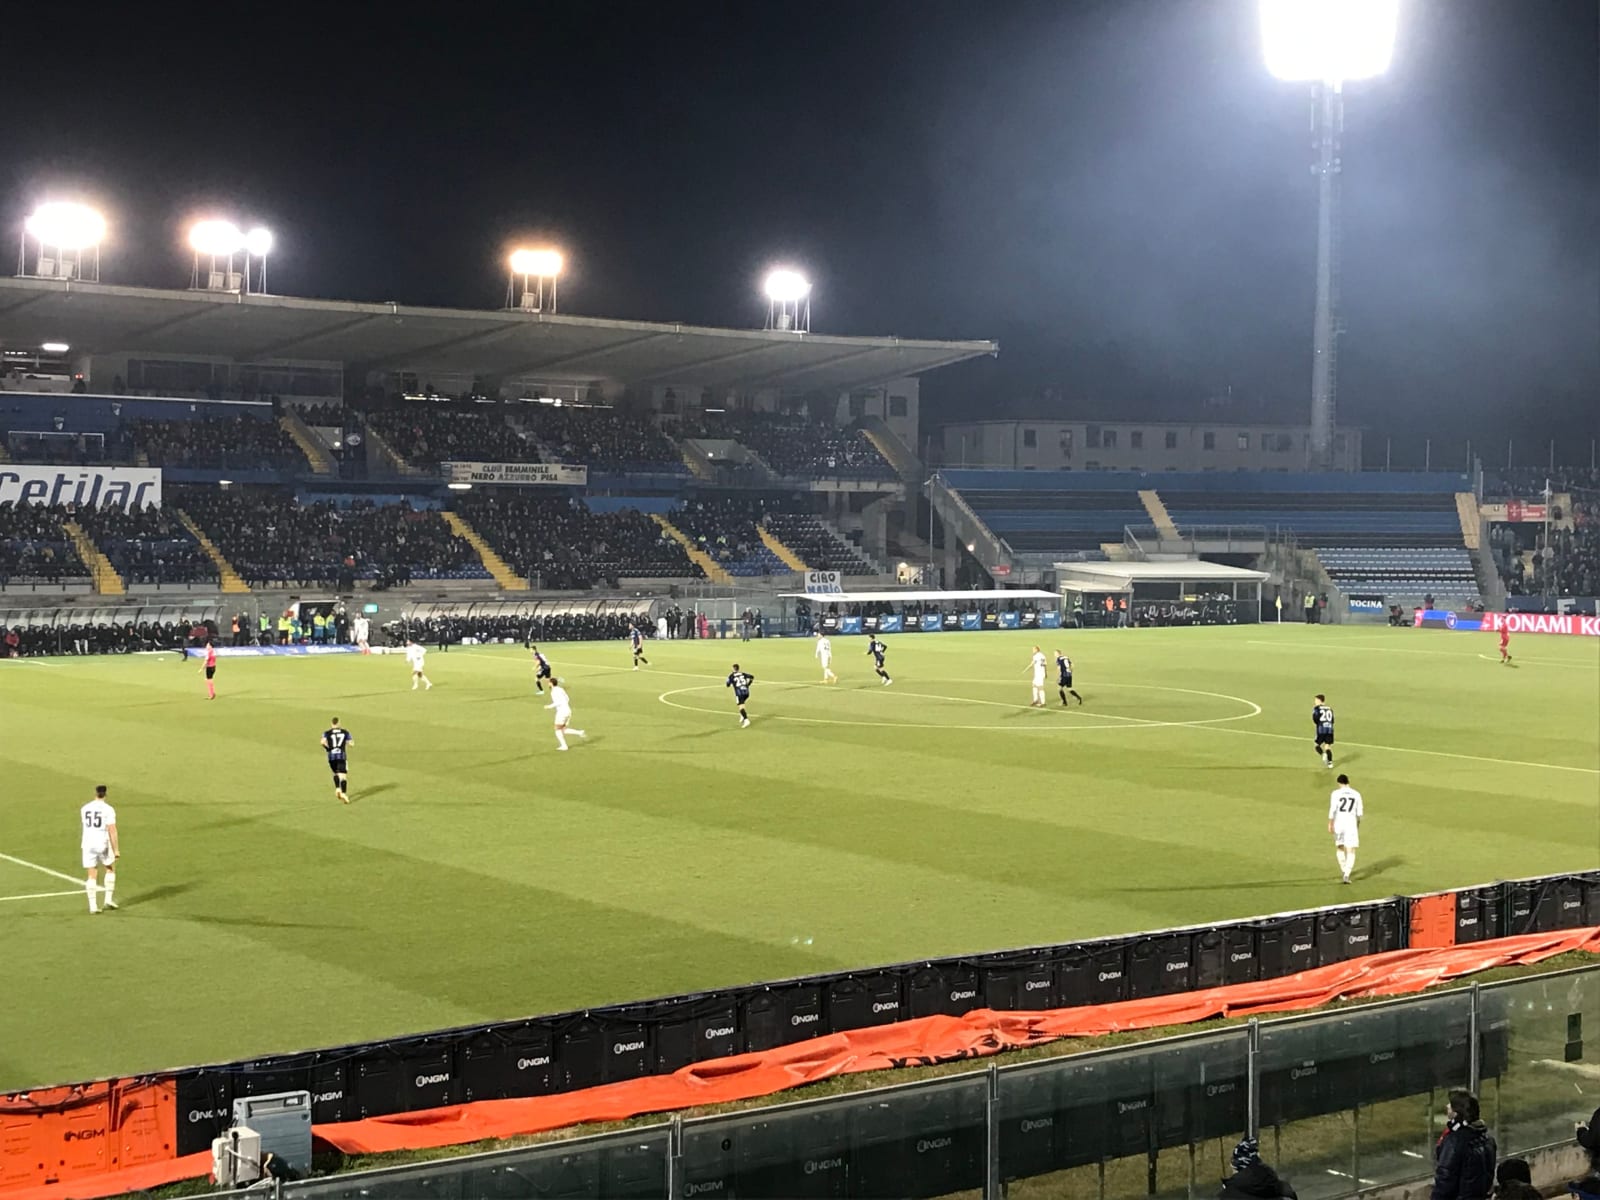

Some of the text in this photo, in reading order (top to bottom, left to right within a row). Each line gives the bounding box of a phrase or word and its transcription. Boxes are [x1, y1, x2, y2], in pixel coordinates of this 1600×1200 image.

[471, 472, 495, 481] NERO
[810, 572, 836, 583] CIAO
[1494, 613, 1572, 634] KONAMI
[733, 676, 746, 688] 25
[1319, 709, 1333, 722] 20
[330, 733, 346, 748] 17
[1339, 797, 1356, 813] 27
[85, 810, 102, 828] 55
